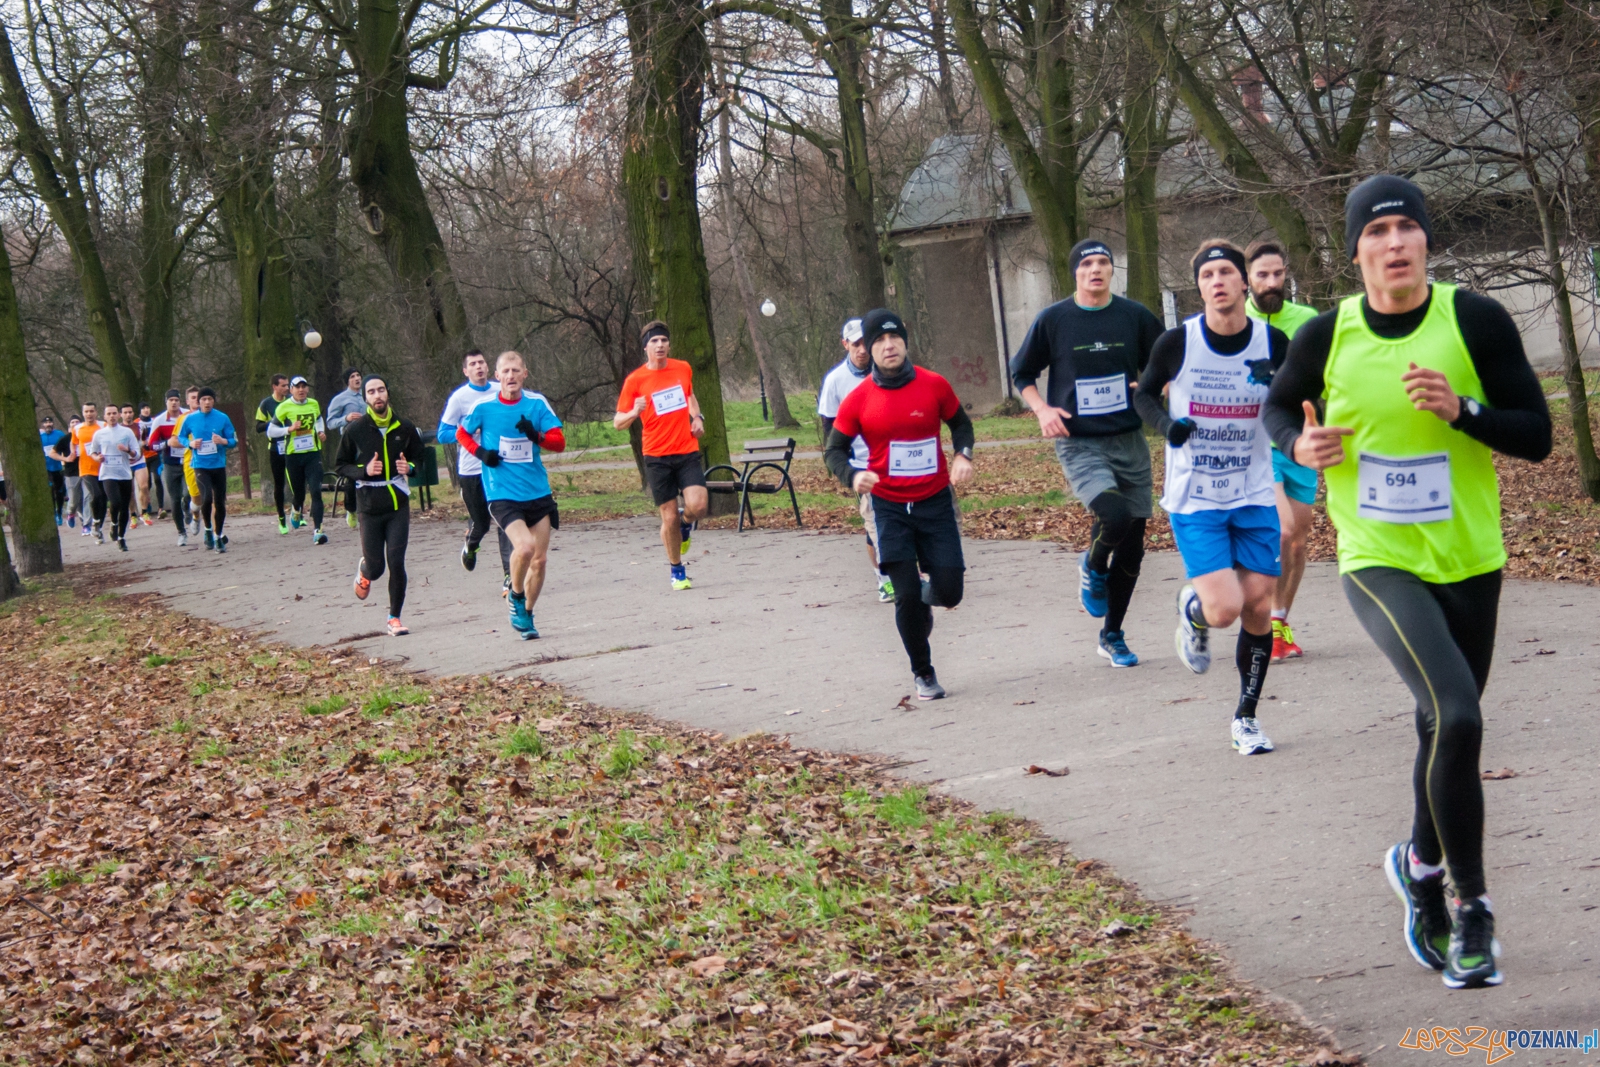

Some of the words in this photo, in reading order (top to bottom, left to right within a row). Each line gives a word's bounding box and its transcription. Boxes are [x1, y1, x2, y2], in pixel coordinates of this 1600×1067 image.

[1190, 368, 1224, 376] AMATORSKI
[1200, 375, 1231, 383] BIEGACZY
[1094, 386, 1111, 395] 448
[907, 449, 923, 458] 708
[1212, 478, 1230, 489] 100
[1385, 472, 1417, 487] 694
